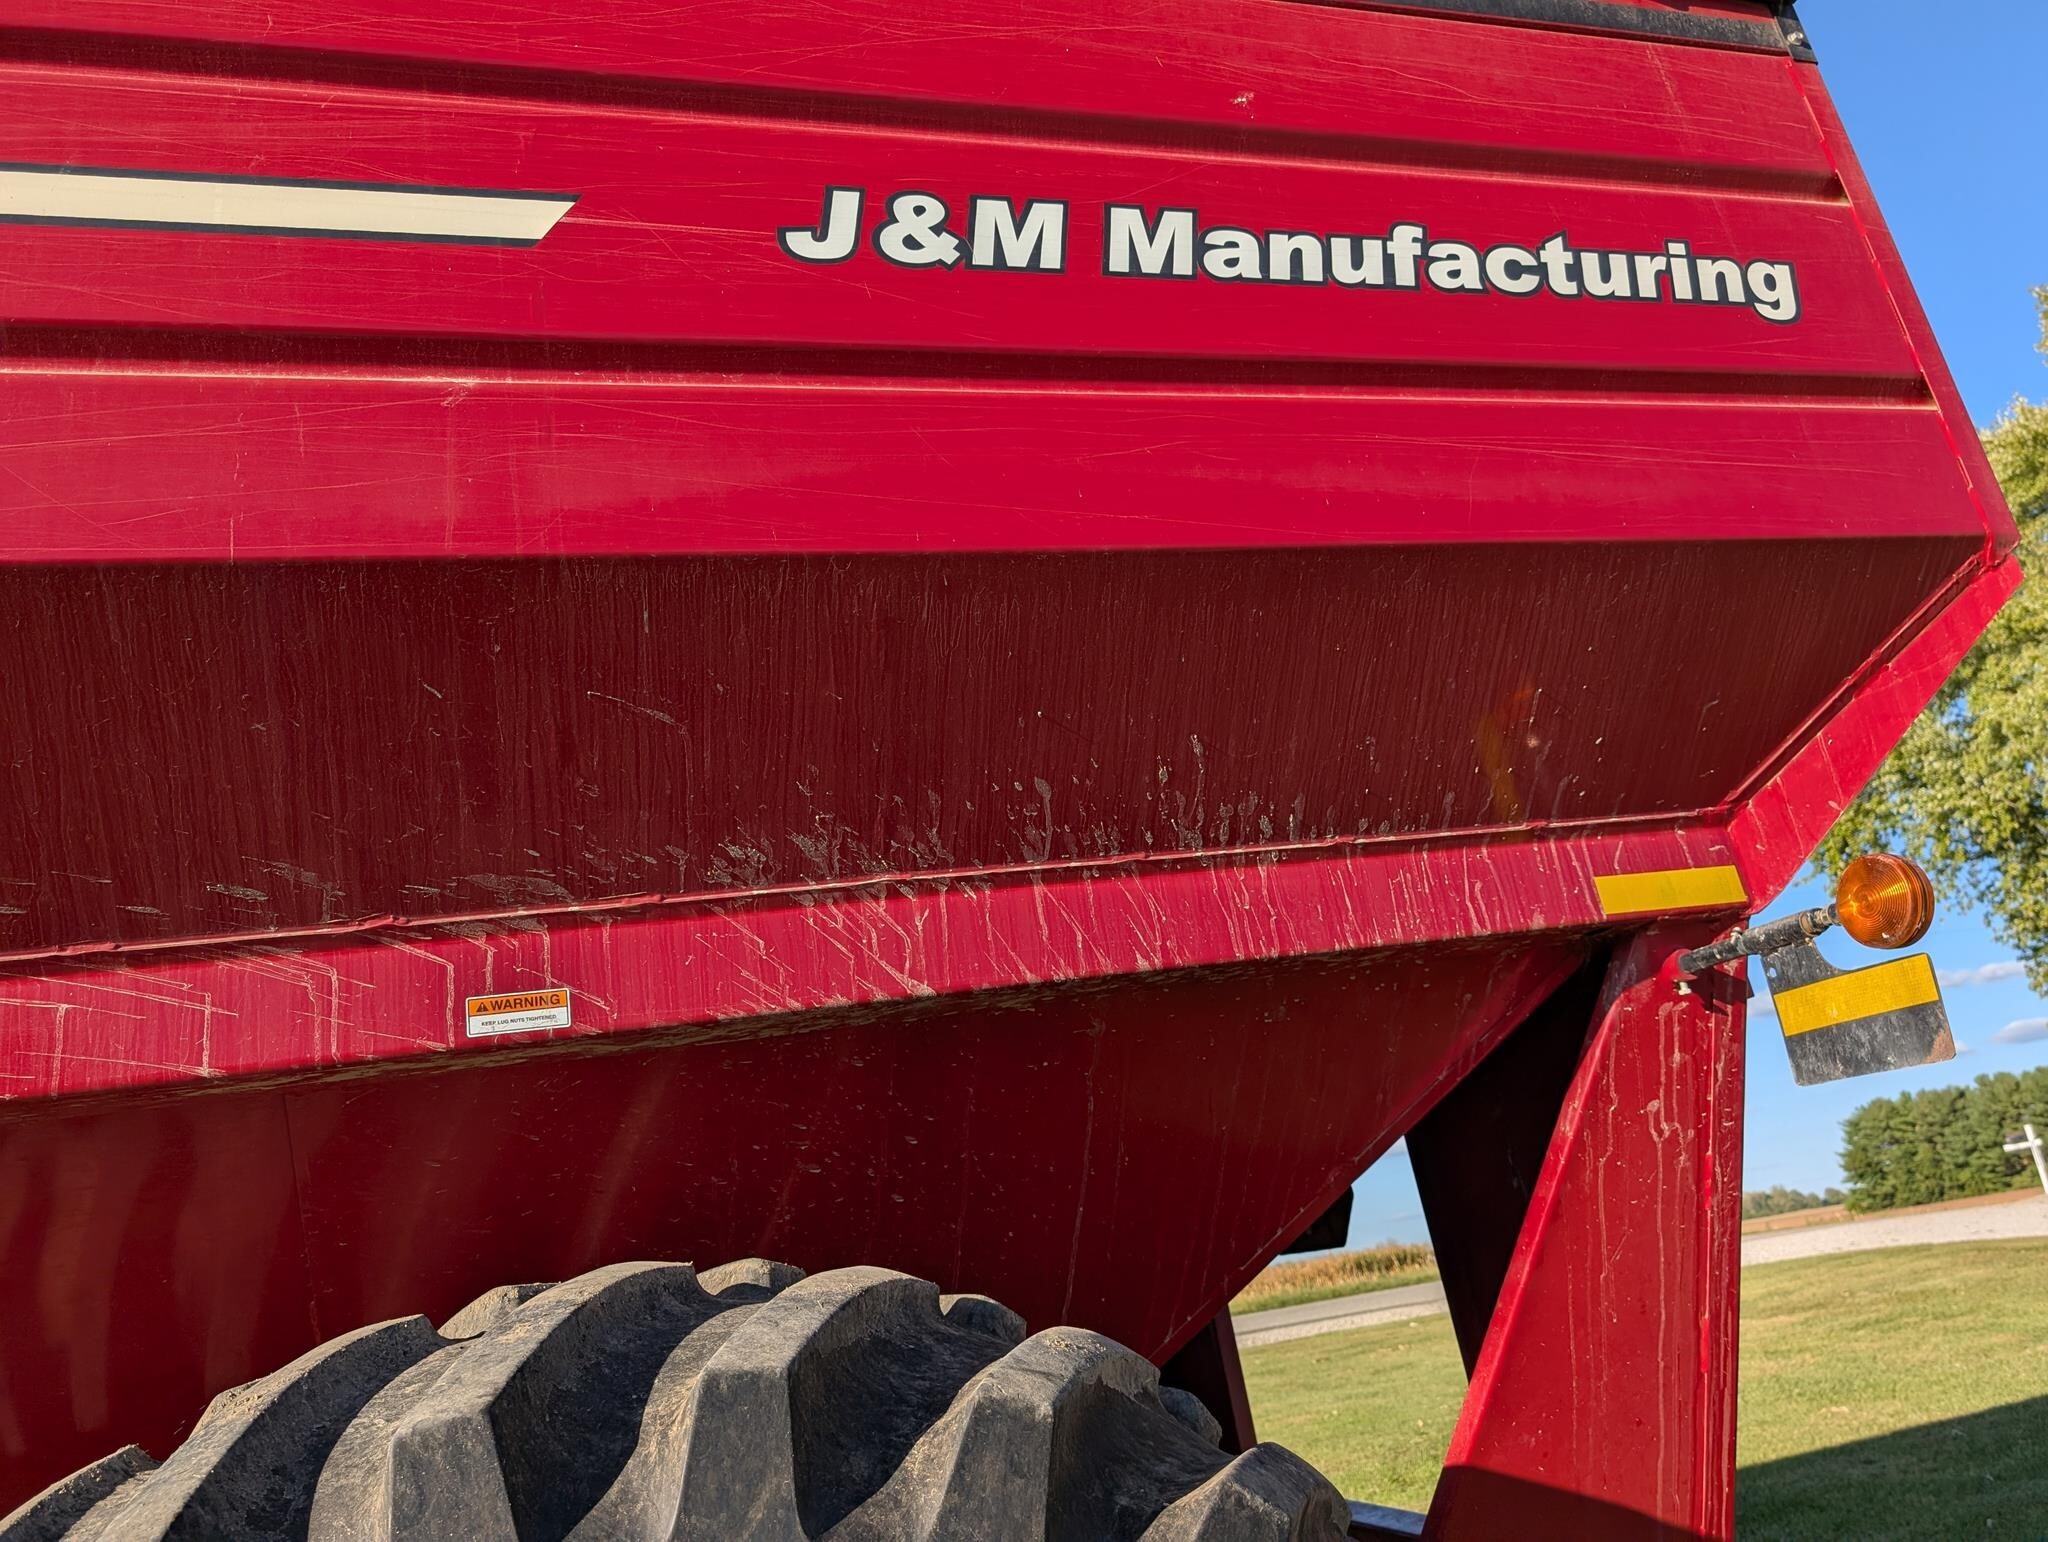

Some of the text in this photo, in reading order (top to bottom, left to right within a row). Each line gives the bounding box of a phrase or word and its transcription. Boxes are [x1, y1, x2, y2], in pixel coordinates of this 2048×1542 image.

[778, 186, 1800, 324] J&M Manufacturing
[490, 994, 560, 1011] WARNING
[526, 1014, 557, 1022] TIGHTENED
